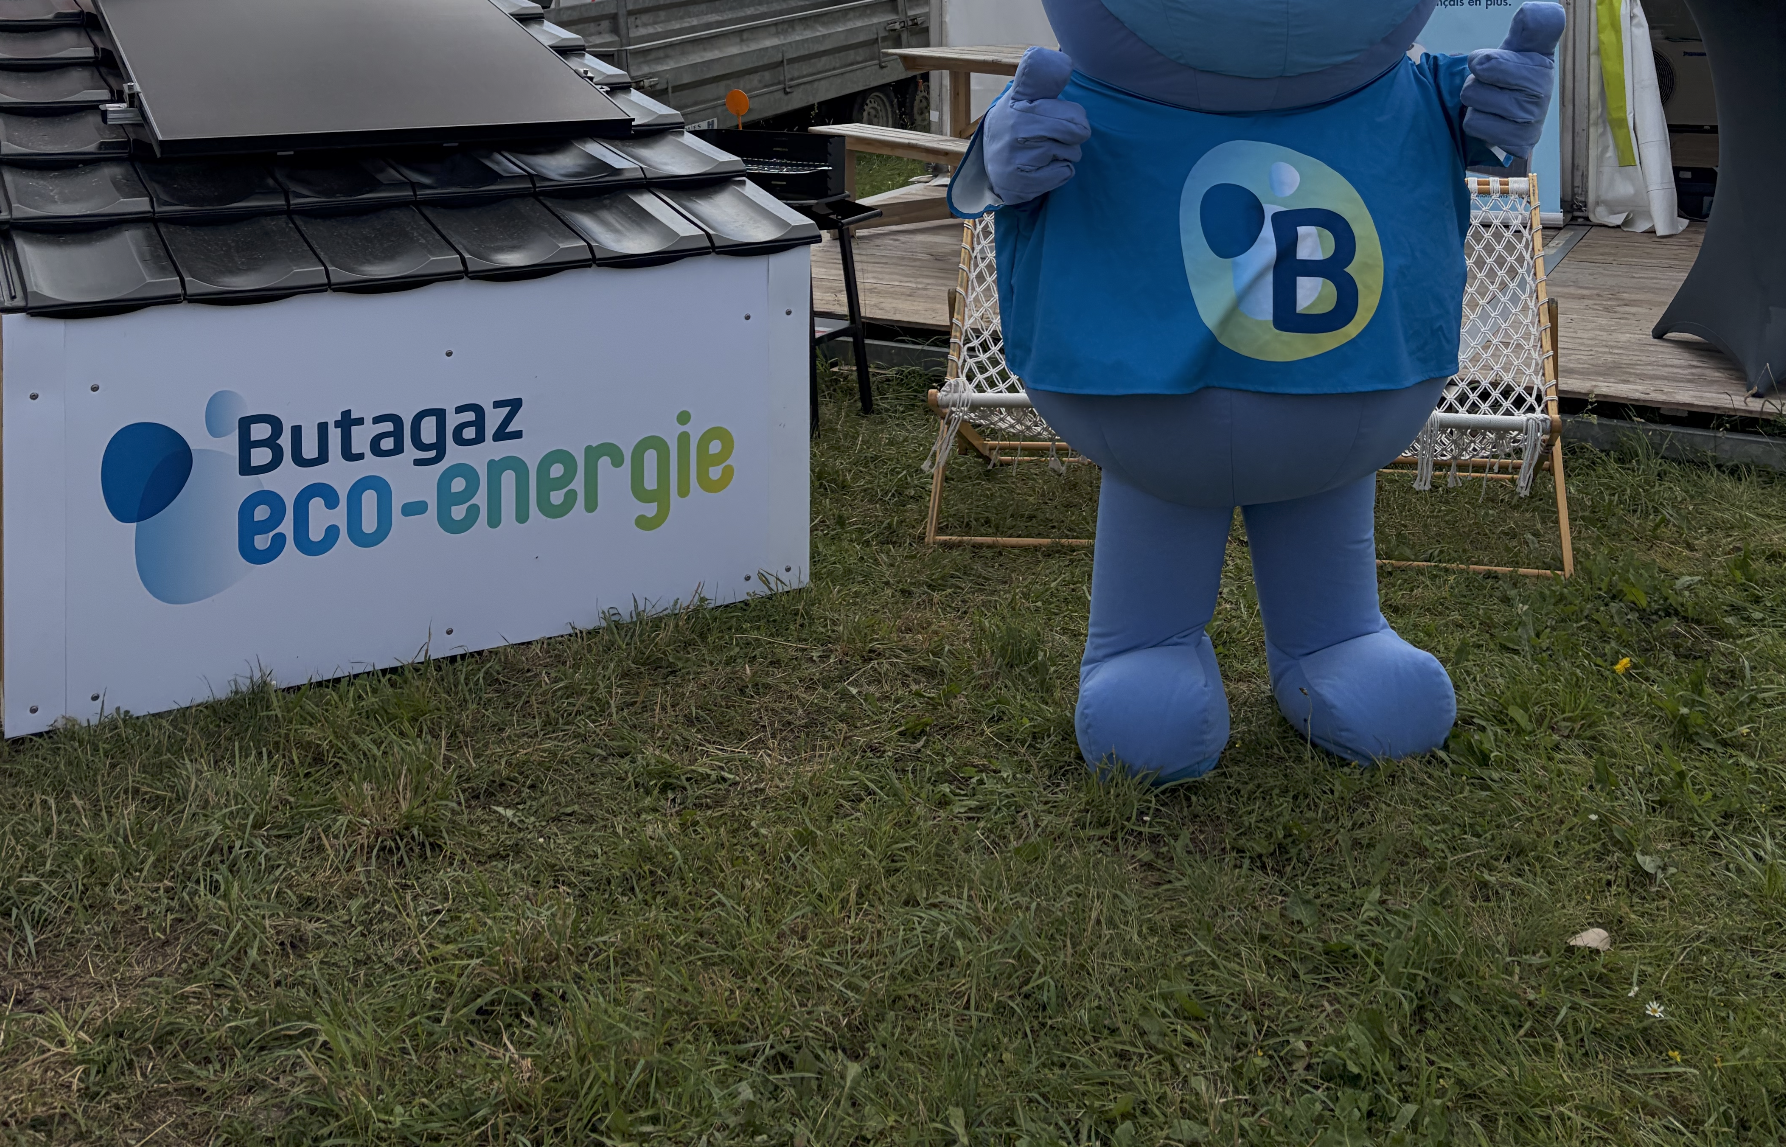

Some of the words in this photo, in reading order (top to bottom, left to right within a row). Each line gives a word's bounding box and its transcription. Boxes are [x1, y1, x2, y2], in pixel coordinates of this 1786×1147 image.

[1271, 207, 1359, 334] B
[237, 410, 735, 566] eco-energie
[238, 397, 524, 476] Butagaz
